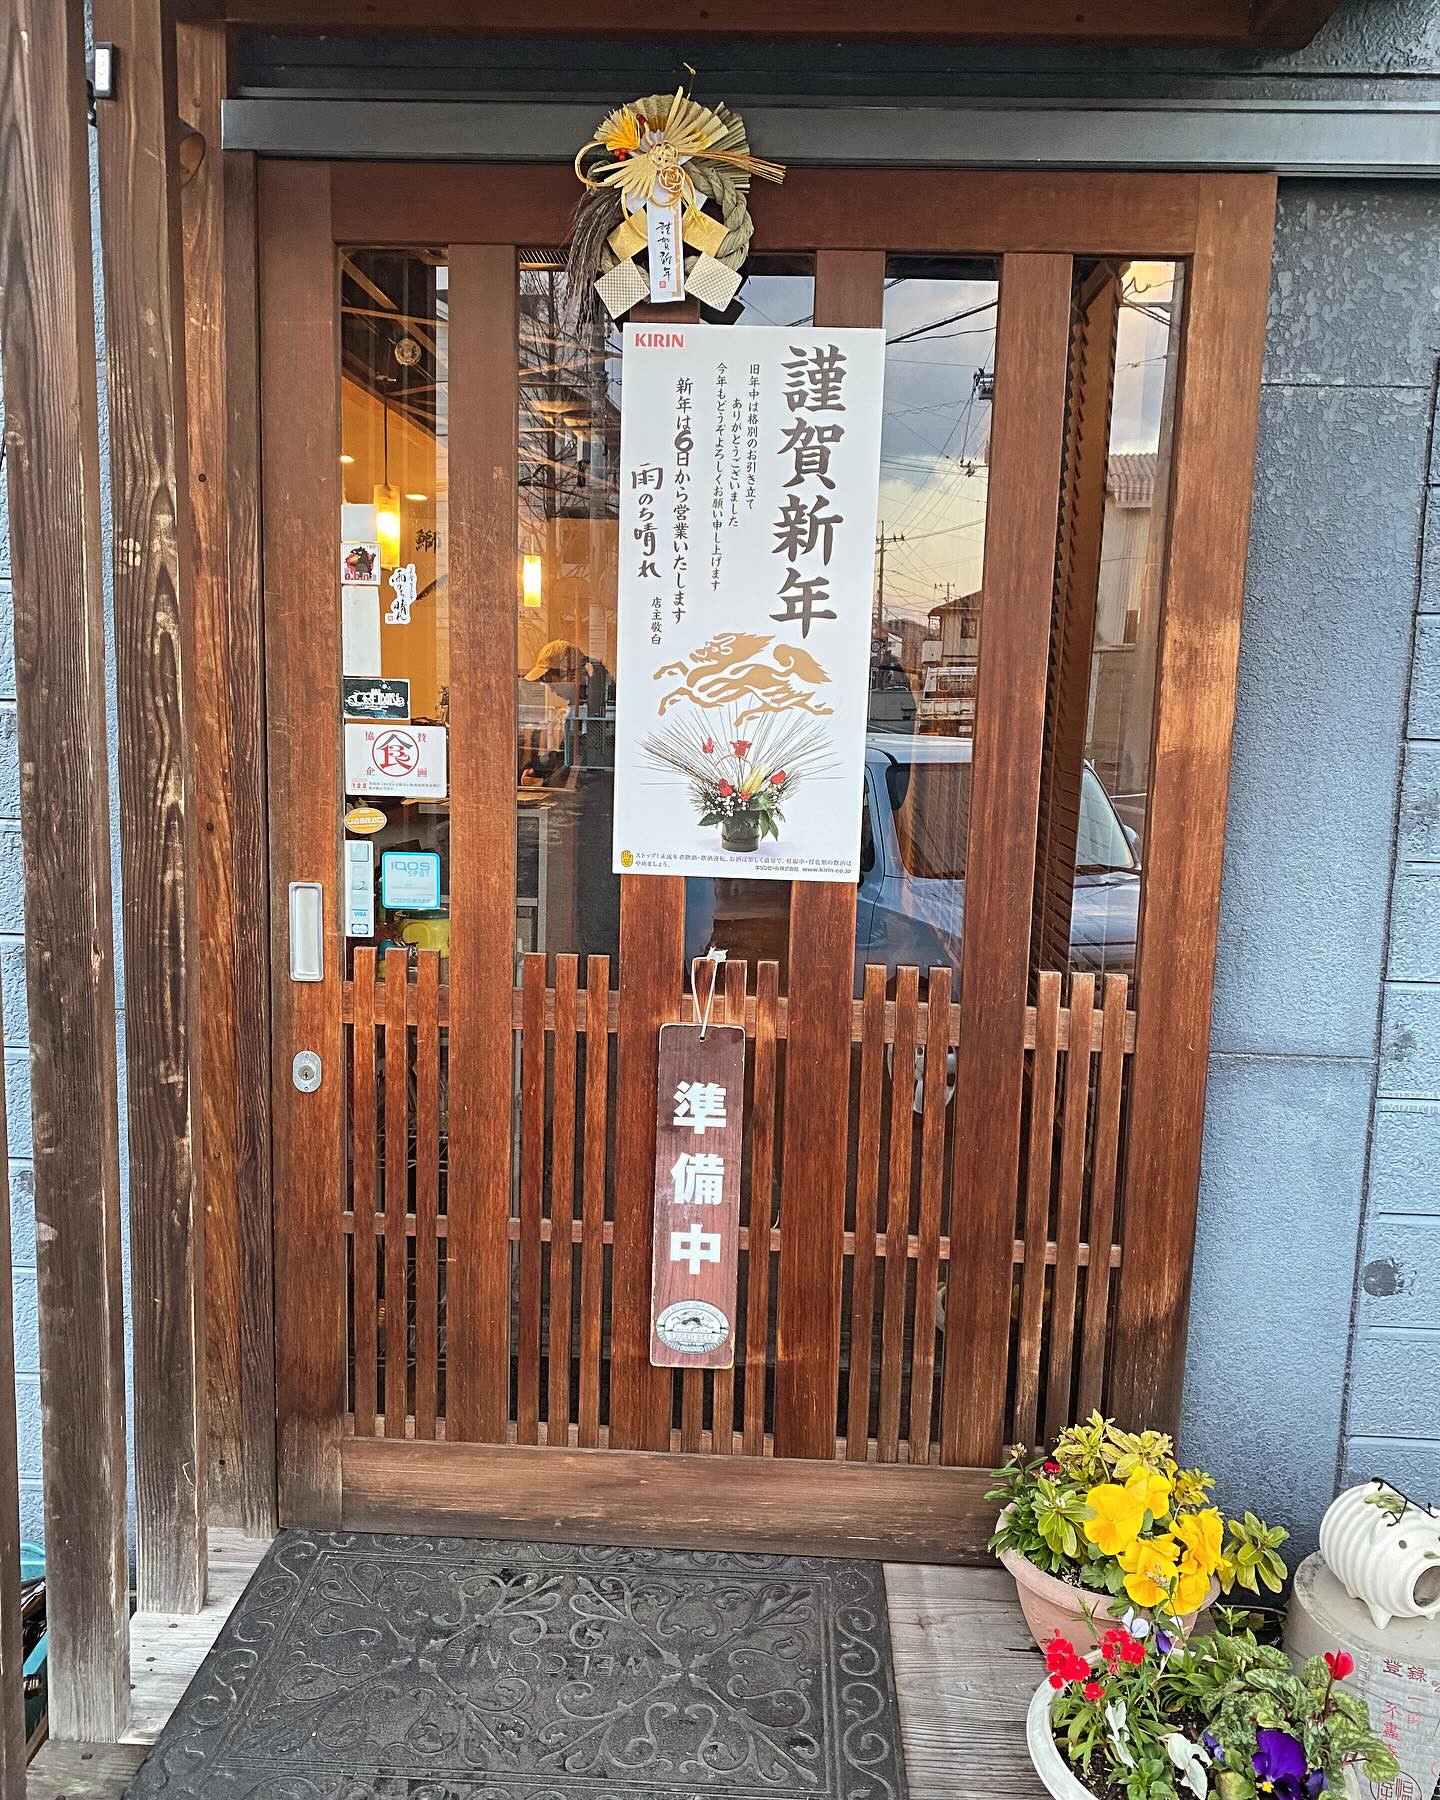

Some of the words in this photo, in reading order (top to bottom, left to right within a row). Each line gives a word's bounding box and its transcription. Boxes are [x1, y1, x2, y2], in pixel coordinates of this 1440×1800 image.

[635, 333, 684, 348] KIRIN
[711, 362, 728, 591] 今年もどうぞよろしくお願い申し上げます
[728, 397, 743, 527] ありがとうございました
[744, 363, 761, 510] 旧年中は格別のお引き立て
[769, 343, 848, 640] 謹賀新年
[631, 462, 664, 579] 雨のち晴れ
[671, 376, 694, 625] 新年は6日から営業いたします
[650, 596, 662, 645] 店主敬白
[347, 816, 384, 825] JASRAC
[391, 861, 430, 871] IQOS
[801, 866, 852, 874] www.kirin.co.jp
[670, 1080, 727, 1275] 準備中
[443, 1645, 652, 1678] WELCOME
